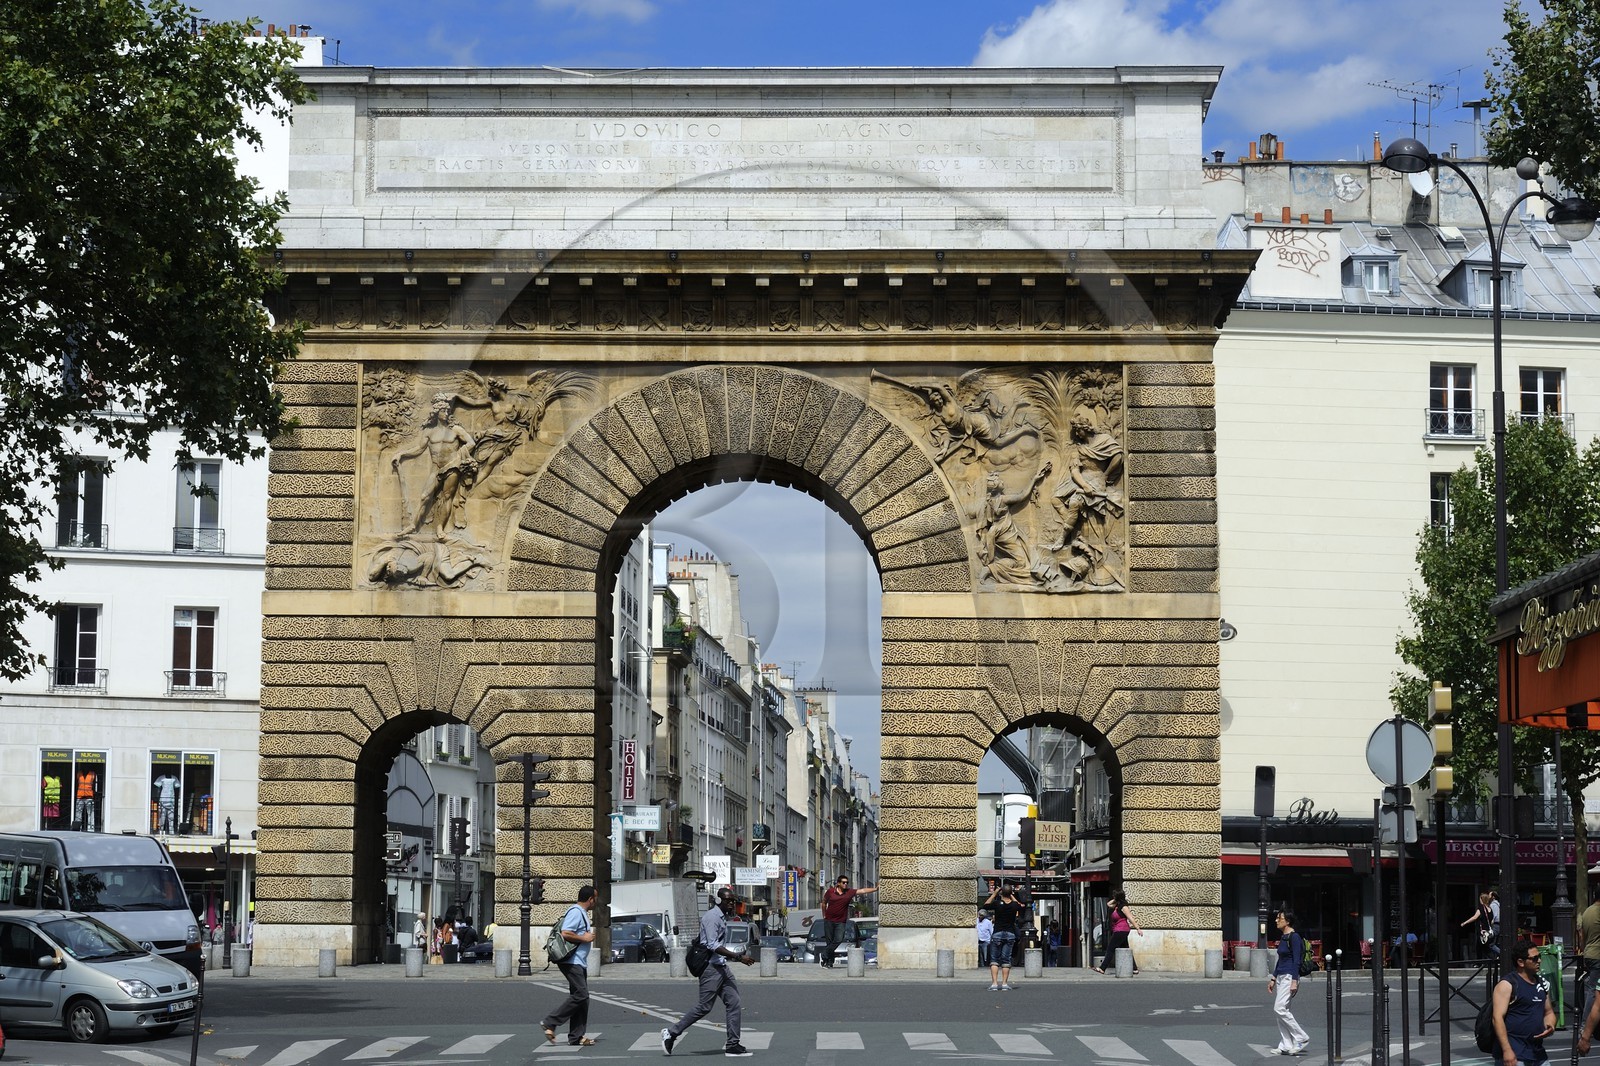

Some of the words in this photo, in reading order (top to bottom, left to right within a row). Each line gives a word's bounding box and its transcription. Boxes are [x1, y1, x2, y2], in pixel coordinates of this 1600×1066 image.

[574, 123, 721, 138] LVDOVICO
[813, 123, 913, 138] MAGNO
[508, 144, 631, 155] VESONTIONE
[671, 144, 805, 156] SEQVANISQVE
[847, 144, 873, 155] BIS
[916, 144, 981, 155] CAPTIS
[389, 159, 410, 170] ET
[426, 159, 504, 170] FRACTIS
[522, 159, 651, 170] GERMANORVM
[807, 160, 961, 171] BATAVORVMQVE
[978, 160, 1101, 170] EXERCITIBVS
[624, 742, 635, 799] HOTEL
[1286, 798, 1341, 824] Bar
[1042, 824, 1063, 833] M.C.
[1038, 833, 1067, 843] ELISE
